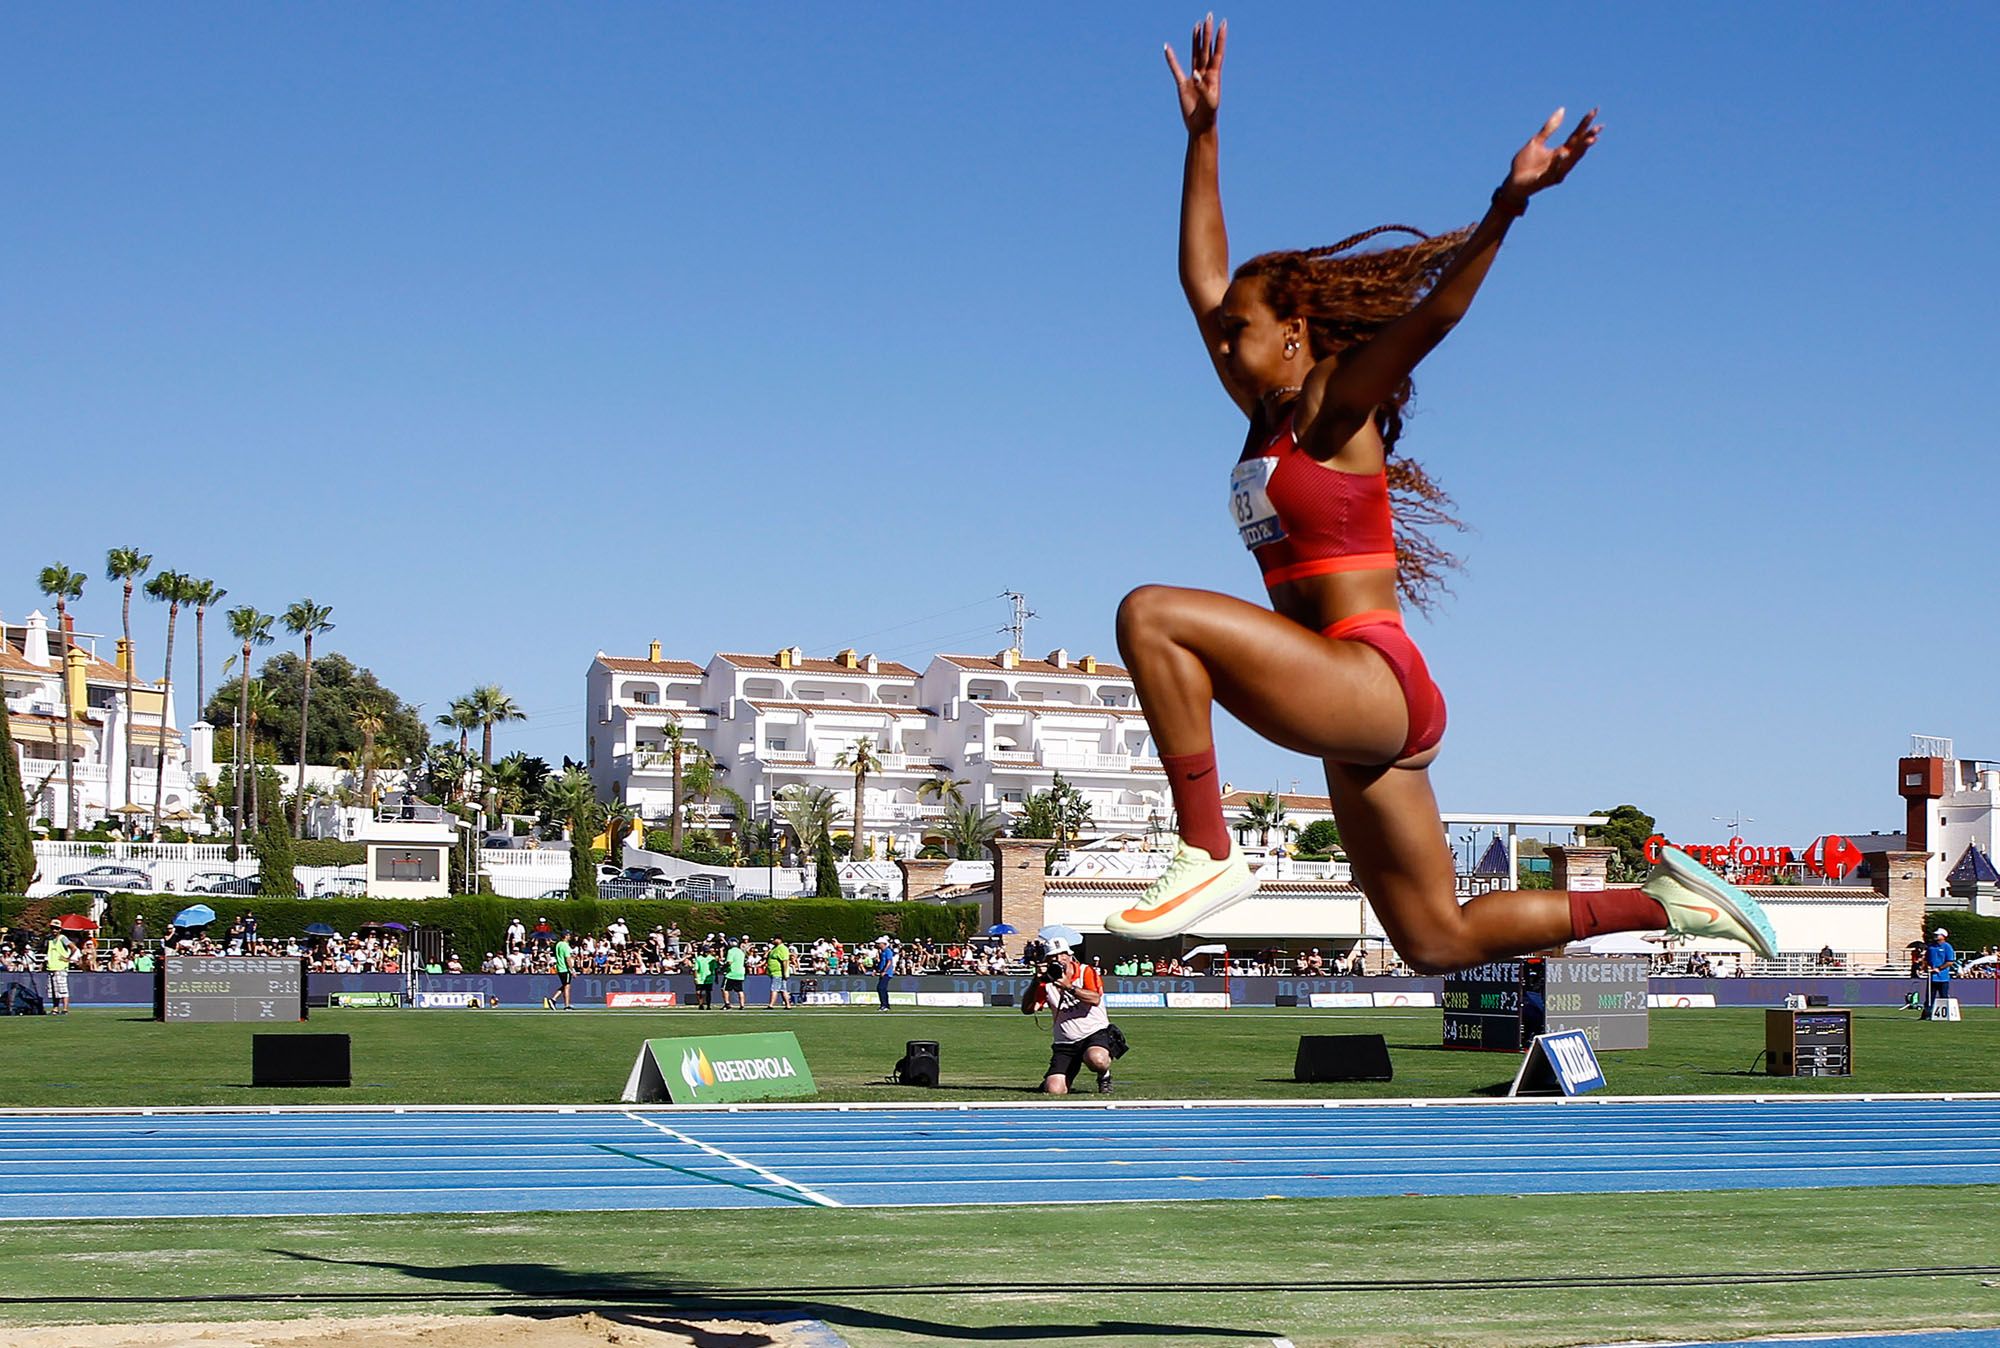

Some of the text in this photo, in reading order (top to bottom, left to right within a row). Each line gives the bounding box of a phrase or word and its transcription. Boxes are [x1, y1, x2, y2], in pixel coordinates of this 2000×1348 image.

[1235, 491, 1253, 522] 83
[167, 960, 300, 974] S JORNET
[1546, 963, 1648, 983] M VICENTE
[167, 981, 231, 993] CARMU
[1500, 991, 1519, 1011] P:2
[1546, 993, 1582, 1011] CNIB
[1624, 991, 1647, 1010] P:2
[1934, 1007, 1948, 1018] 40
[712, 1057, 797, 1082] IBERDROLA
